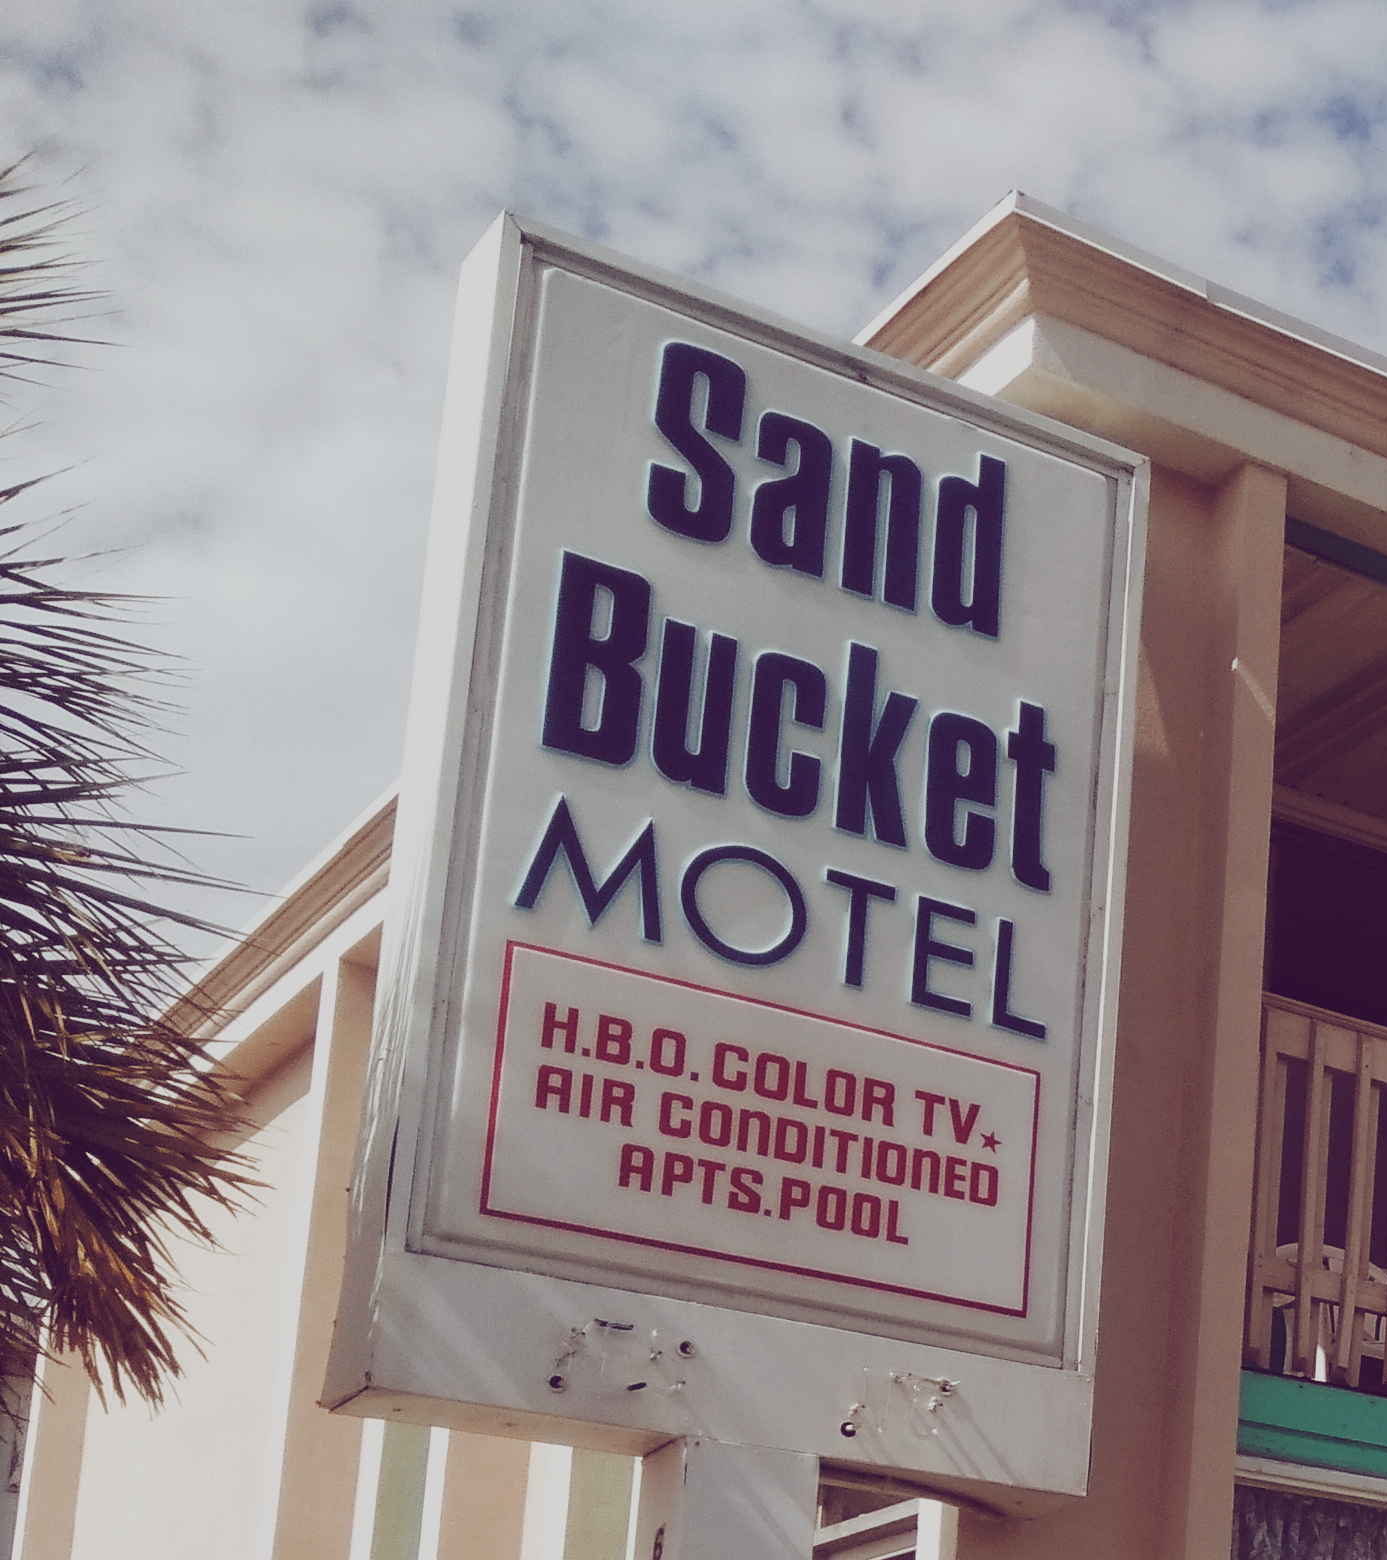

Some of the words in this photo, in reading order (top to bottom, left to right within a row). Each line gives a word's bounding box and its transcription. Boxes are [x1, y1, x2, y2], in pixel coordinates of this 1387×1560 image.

[648, 343, 1007, 641] Sand
[543, 551, 1057, 896] Bucket
[515, 796, 1048, 1043] MOTEL
[535, 1065, 636, 1128] AIR
[659, 1091, 999, 1207] CONDITIONED
[712, 1042, 896, 1128] COLOR
